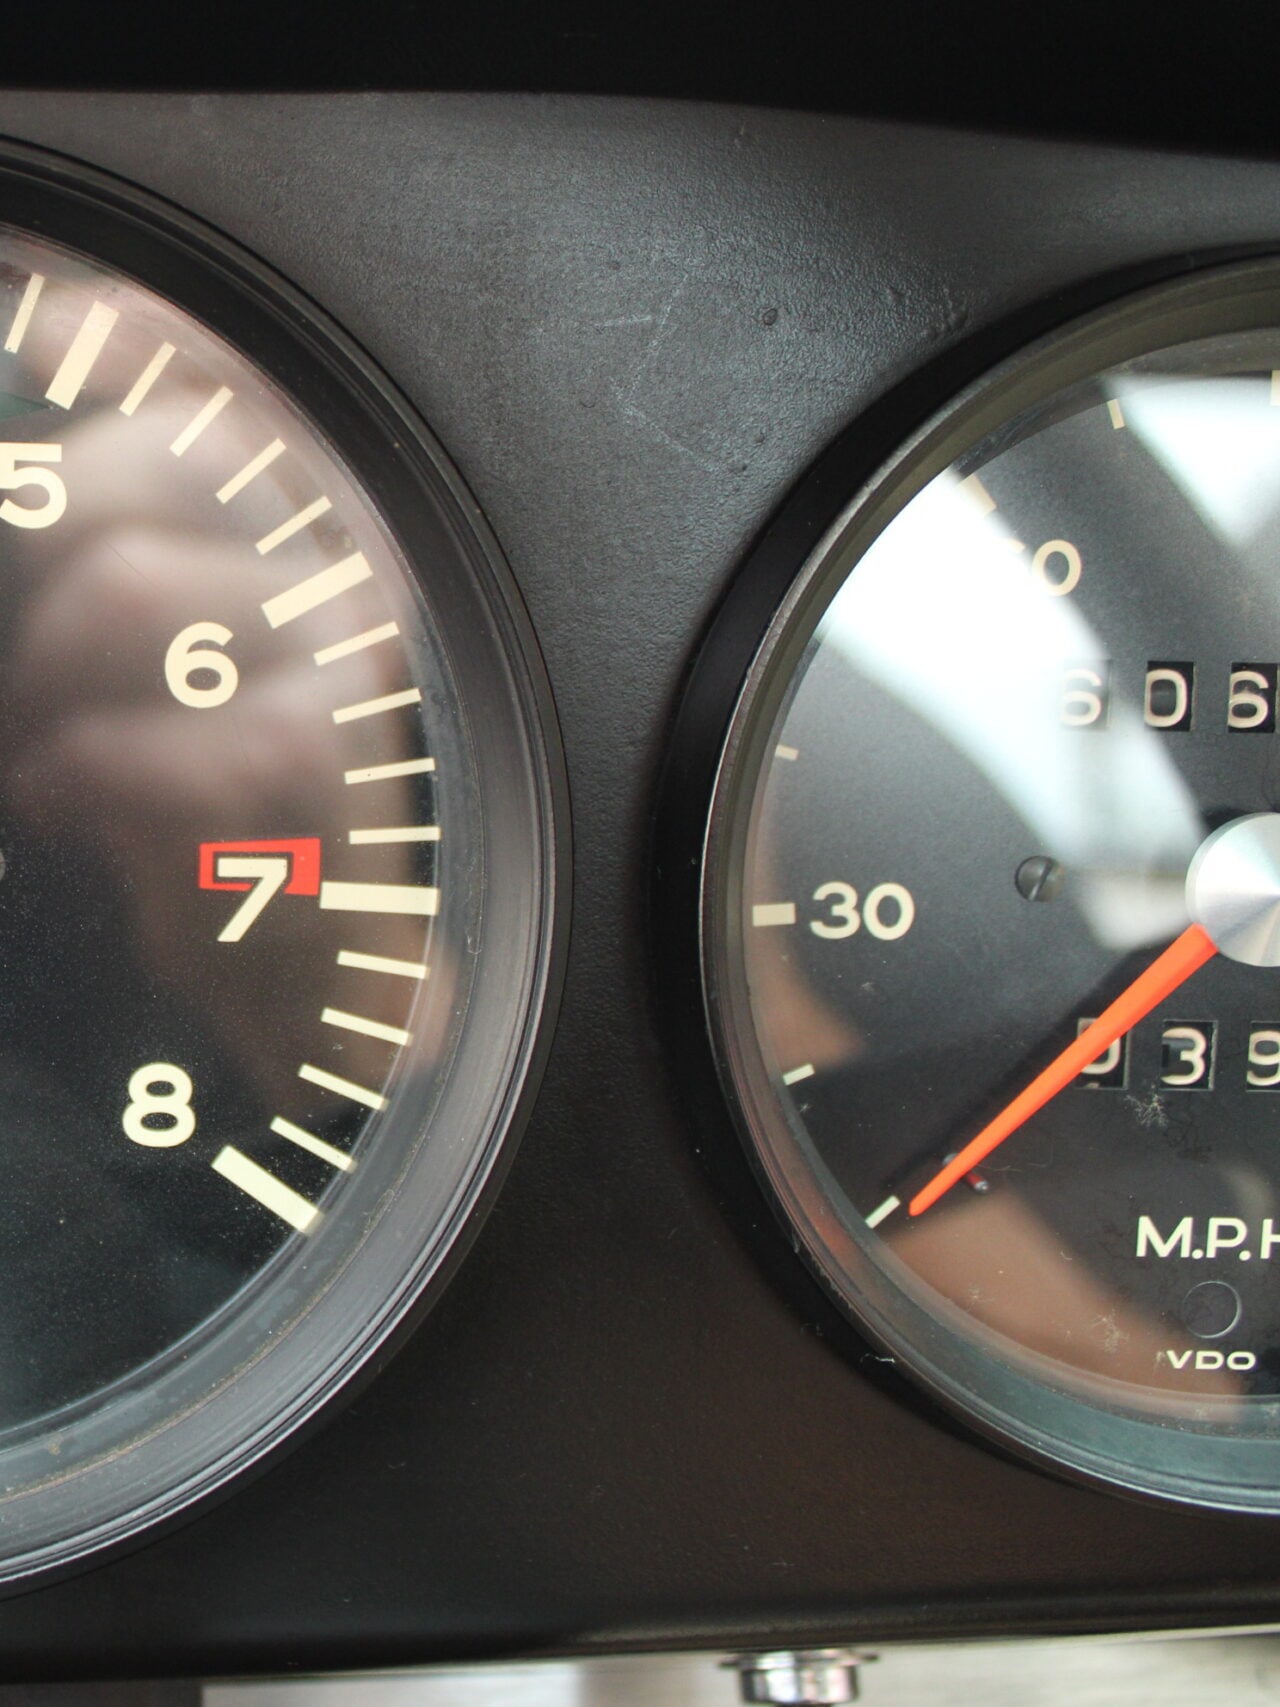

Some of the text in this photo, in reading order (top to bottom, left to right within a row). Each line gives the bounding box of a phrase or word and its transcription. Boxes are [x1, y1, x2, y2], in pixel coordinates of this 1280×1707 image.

[164, 621, 239, 709] 6
[218, 857, 288, 943] 7
[810, 881, 915, 941] 30
[122, 1062, 196, 1148] 8
[1166, 1349, 1256, 1370] VDO
